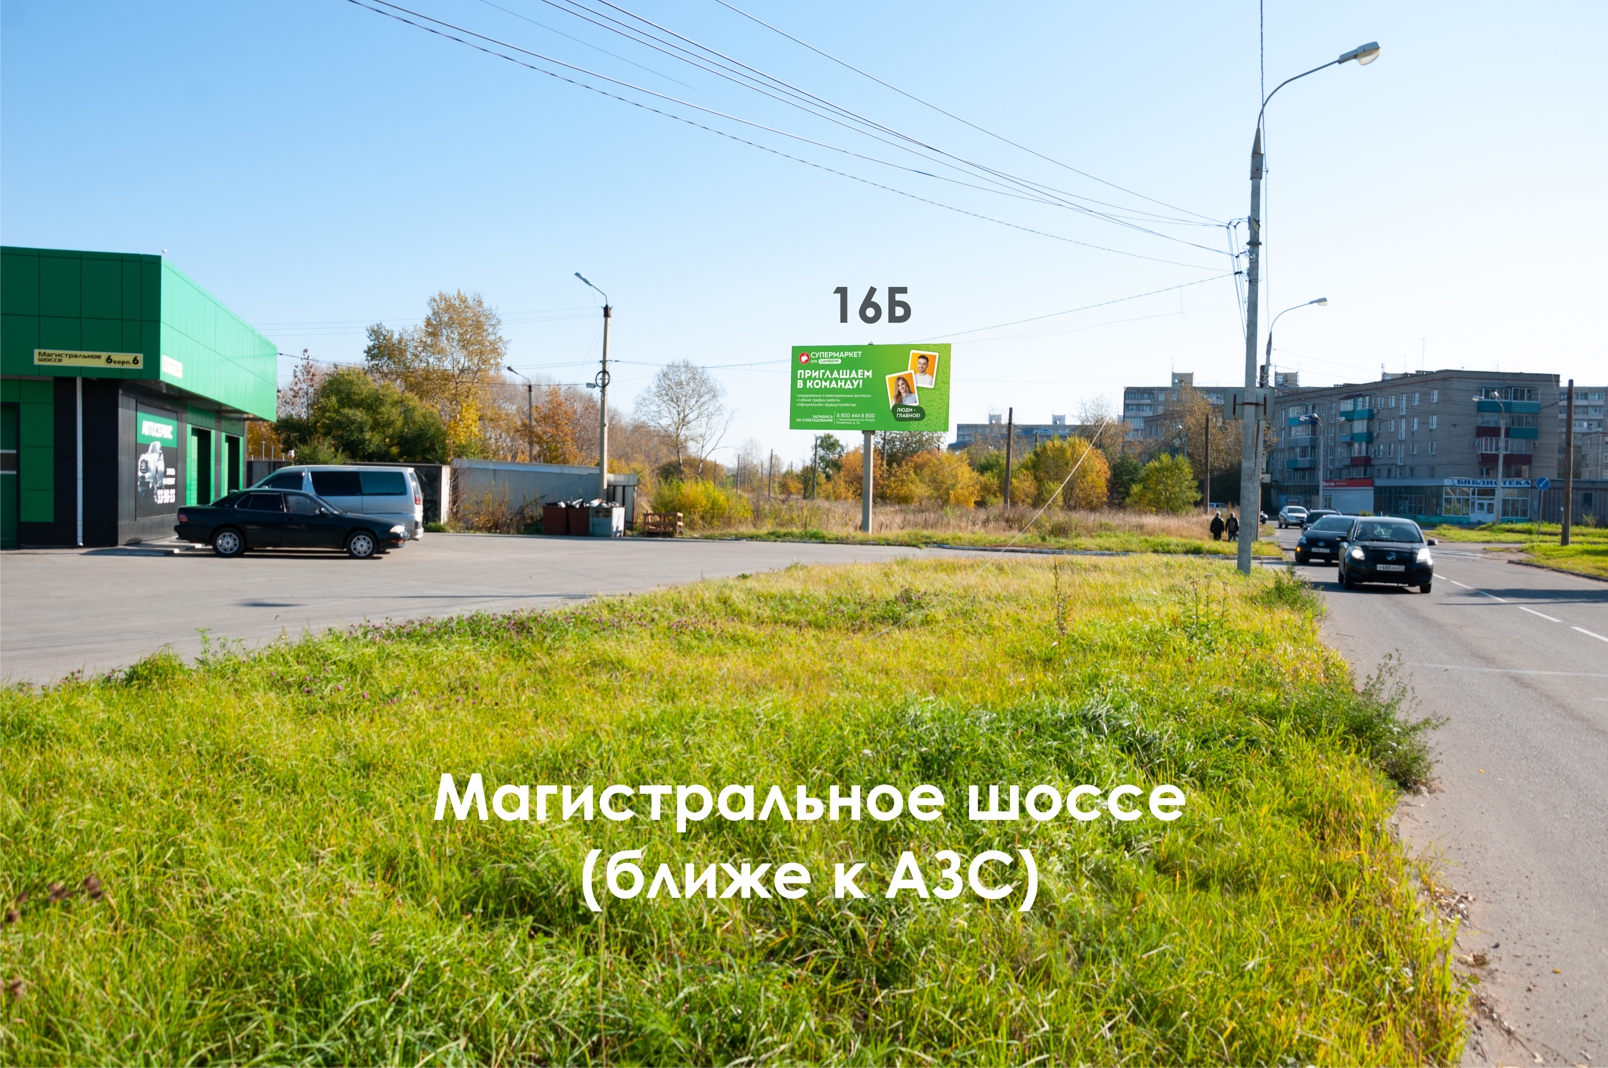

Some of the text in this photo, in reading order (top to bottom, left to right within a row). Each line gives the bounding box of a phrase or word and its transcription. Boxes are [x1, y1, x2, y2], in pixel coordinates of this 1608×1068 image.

[38, 351, 102, 360] Магистральное
[797, 369, 873, 379] ПРИГЛАШАЕМ
[797, 379, 863, 389] В КОМАНДУ!
